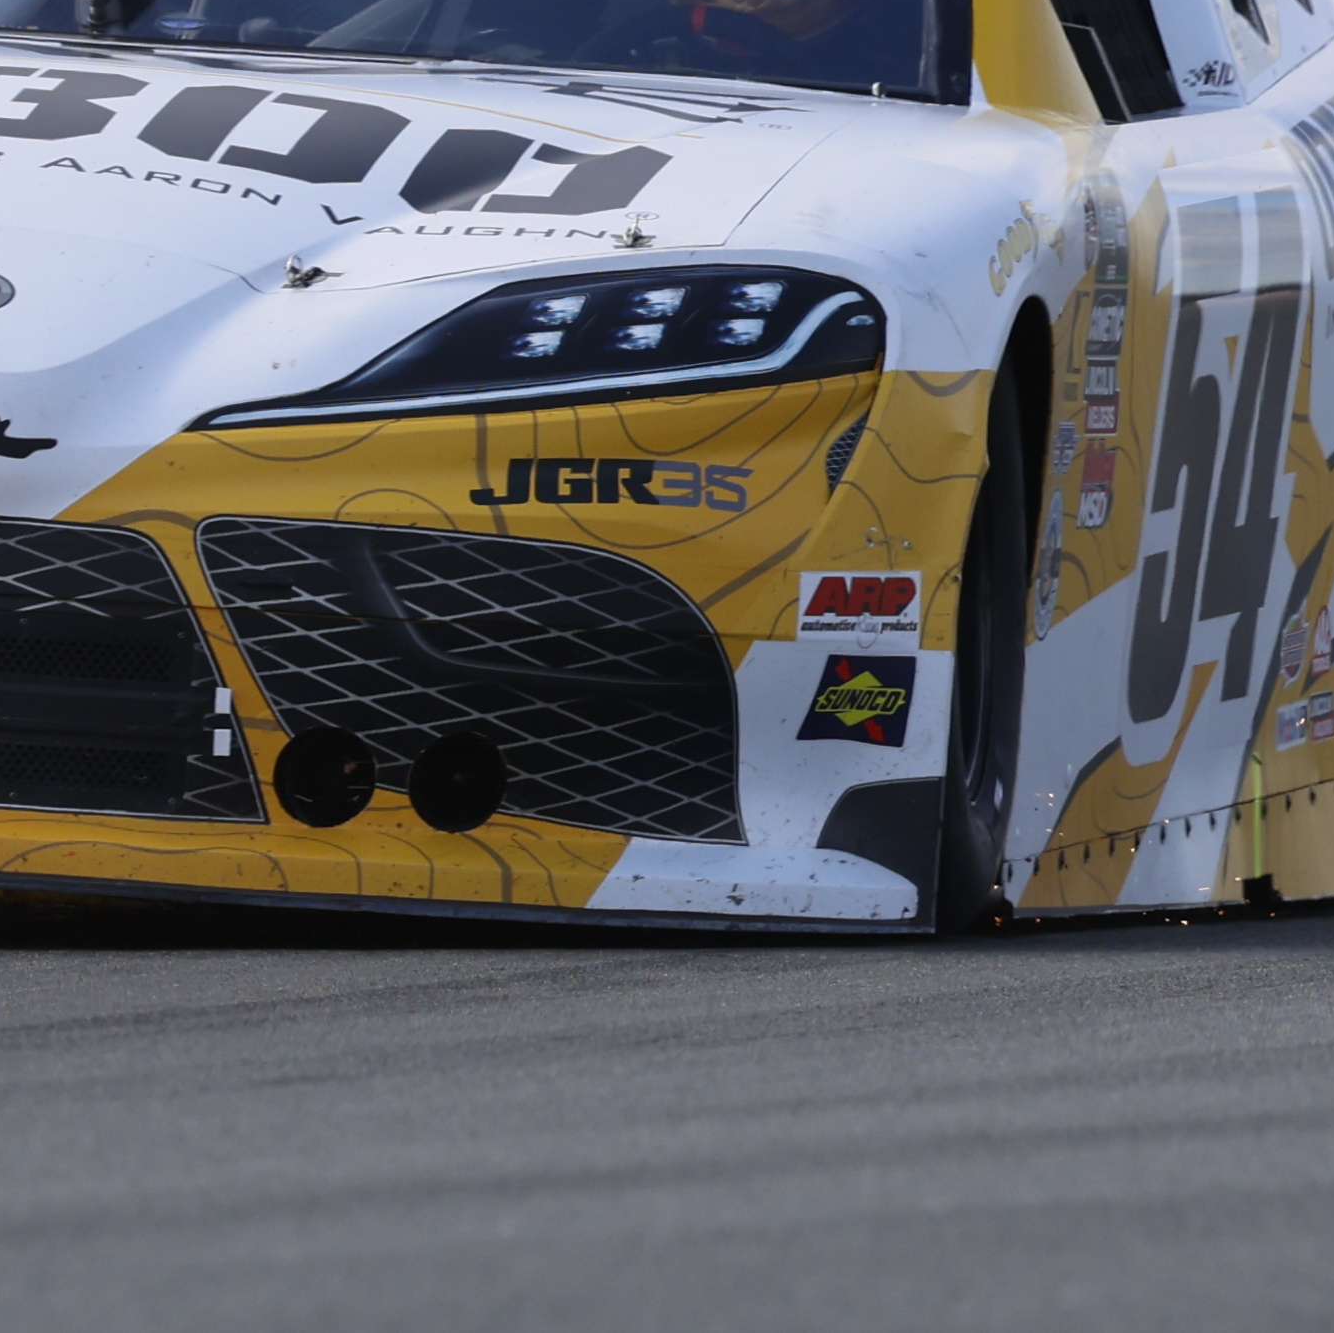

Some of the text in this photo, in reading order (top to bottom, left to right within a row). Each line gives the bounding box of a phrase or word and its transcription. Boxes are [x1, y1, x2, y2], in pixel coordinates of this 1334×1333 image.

[39, 156, 282, 207] AARON
[319, 202, 609, 240] VAUGHN
[1125, 182, 1307, 726] 54
[804, 576, 917, 617] ARP
[800, 619, 858, 632] automotive
[879, 619, 918, 634] products
[817, 688, 903, 712] SUNOCO
